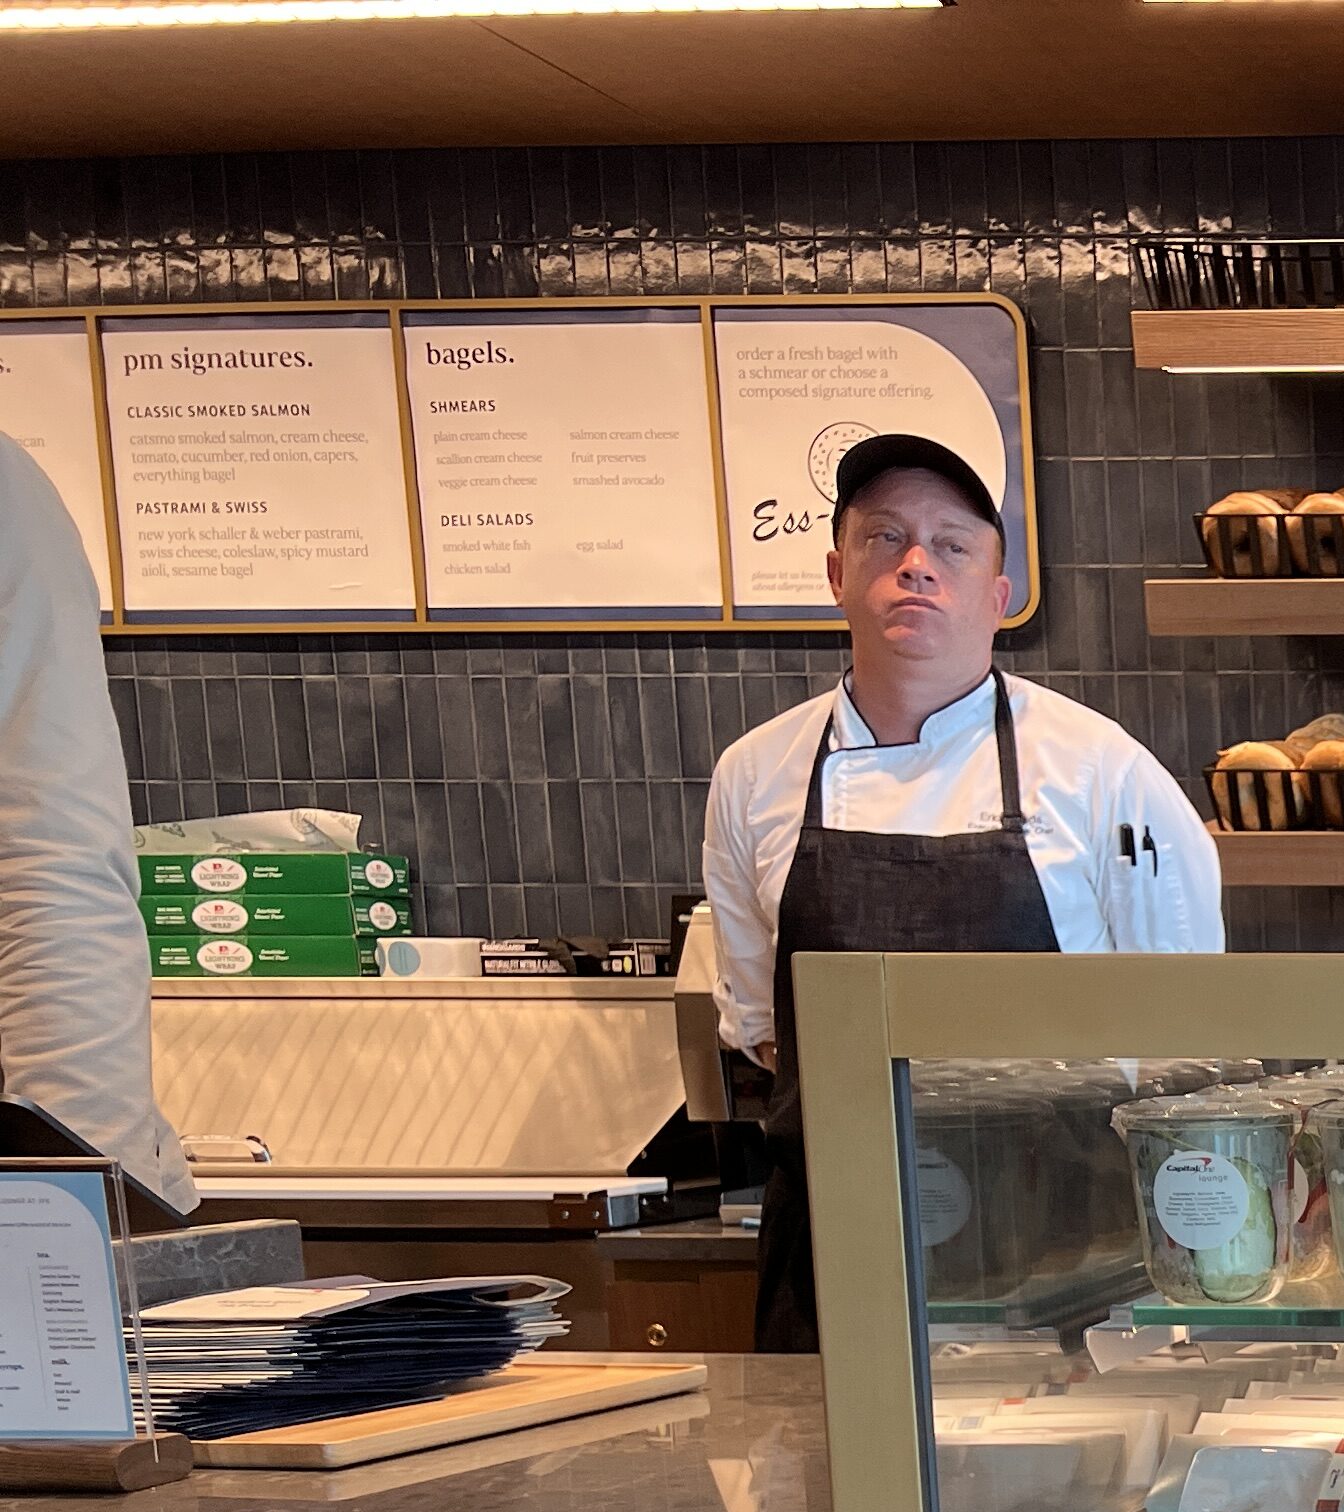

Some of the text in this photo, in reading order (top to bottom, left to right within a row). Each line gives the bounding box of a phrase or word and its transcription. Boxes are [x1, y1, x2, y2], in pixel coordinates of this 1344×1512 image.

[426, 341, 514, 370] bagels.
[737, 346, 897, 362] order a fresh bagel with
[123, 347, 313, 376] pm signatures.
[738, 365, 888, 379] a schmear or choose a
[739, 384, 933, 400] composed signature offering.
[127, 404, 310, 418] CLASSIC SMOKED SALMON
[430, 400, 496, 413] SHMEARS
[178, 431, 226, 444] smoked
[229, 431, 278, 445] salmon,
[281, 432, 320, 443] cream
[323, 431, 368, 444] cheese,
[460, 431, 490, 441] cream
[492, 430, 527, 440] cheese
[570, 429, 679, 440] salmon cream cheese
[132, 449, 358, 465] tomato, cucumber, red onion, capers,
[571, 452, 646, 465] fruit preserves
[134, 468, 236, 483] everything bagel
[573, 475, 664, 486] smashed avocado
[136, 501, 268, 514] PASTRAMI & SWISS
[441, 513, 533, 527] DELI SALADS
[138, 527, 363, 543] new york schaller & weber pastrami,
[139, 544, 368, 560] swiss cheese, coleslaw, spicy mustard
[576, 540, 623, 552] egg salad
[142, 564, 253, 579] aioli, sesame bagel
